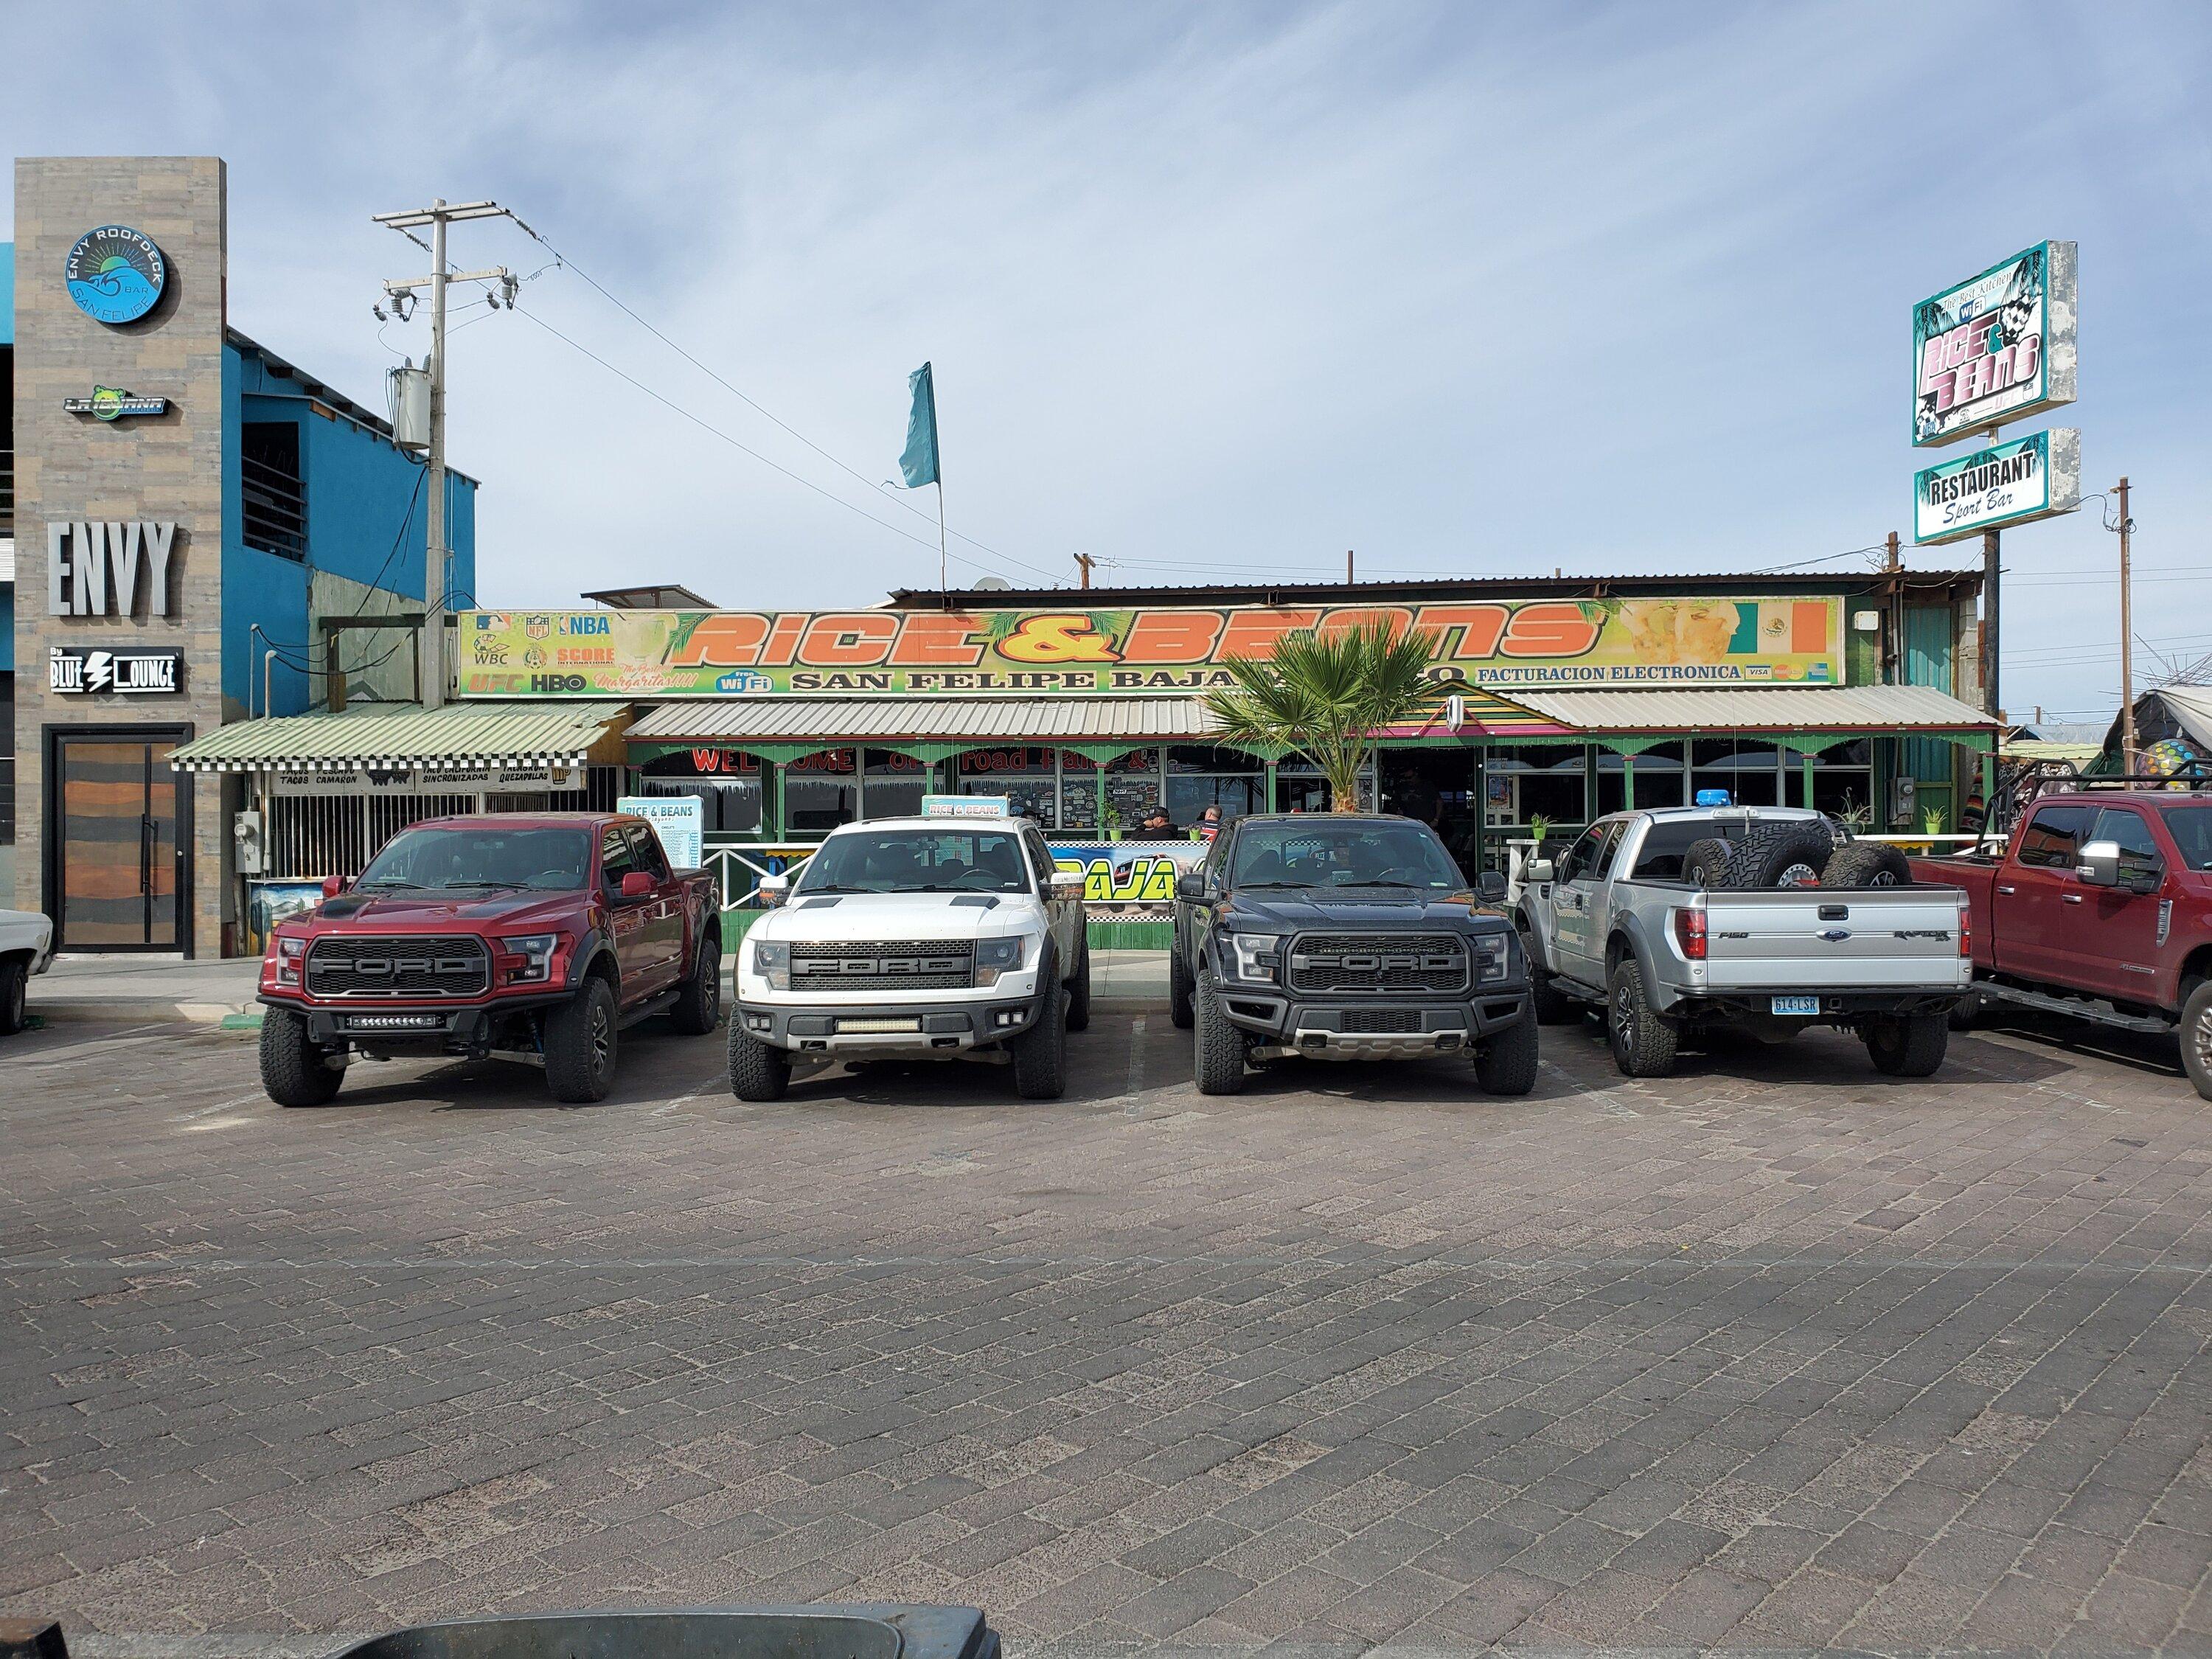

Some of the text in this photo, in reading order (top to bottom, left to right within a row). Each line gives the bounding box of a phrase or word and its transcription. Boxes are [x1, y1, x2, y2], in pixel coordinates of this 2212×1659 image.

[68, 228, 161, 283] ENVY ROOFDECK
[1943, 270, 2012, 313] The Best Kitchen
[72, 288, 152, 321] SAN FELIPE
[1919, 309, 2004, 397] RICE &
[1935, 333, 2040, 414] BEANS
[1923, 421, 1935, 437] NBA
[1931, 451, 2034, 507] RESTAURANT
[1943, 488, 2013, 525] Sport Bar
[47, 521, 177, 618] ENVY
[528, 625, 546, 635] NFL
[570, 616, 610, 635] NBA
[662, 612, 986, 669] RICE
[994, 613, 1126, 664] &
[50, 647, 63, 656] By
[475, 653, 508, 664] WBC
[557, 648, 615, 661] SCORE
[50, 660, 175, 688] BLUE LOUNGE
[793, 670, 1239, 690] SAN FELIPE BAJA
[1477, 667, 1606, 682] FACTURACION
[1610, 665, 1742, 680] ELECTRONICA
[467, 673, 524, 693] UFC
[531, 674, 587, 692] HBO
[961, 746, 1027, 770] road
[1128, 751, 1147, 769] &
[280, 776, 358, 785] TACOS CAMARON
[422, 774, 488, 783] SINCRONIZADAS
[651, 807, 658, 816] &
[661, 807, 693, 816] BEANS
[931, 805, 953, 814] RICE
[965, 806, 1000, 815] BEANS
[1893, 931, 1951, 941] RAPTOR
[309, 958, 481, 974] FORD
[791, 959, 967, 974] FORD
[1292, 956, 1467, 970] FORD
